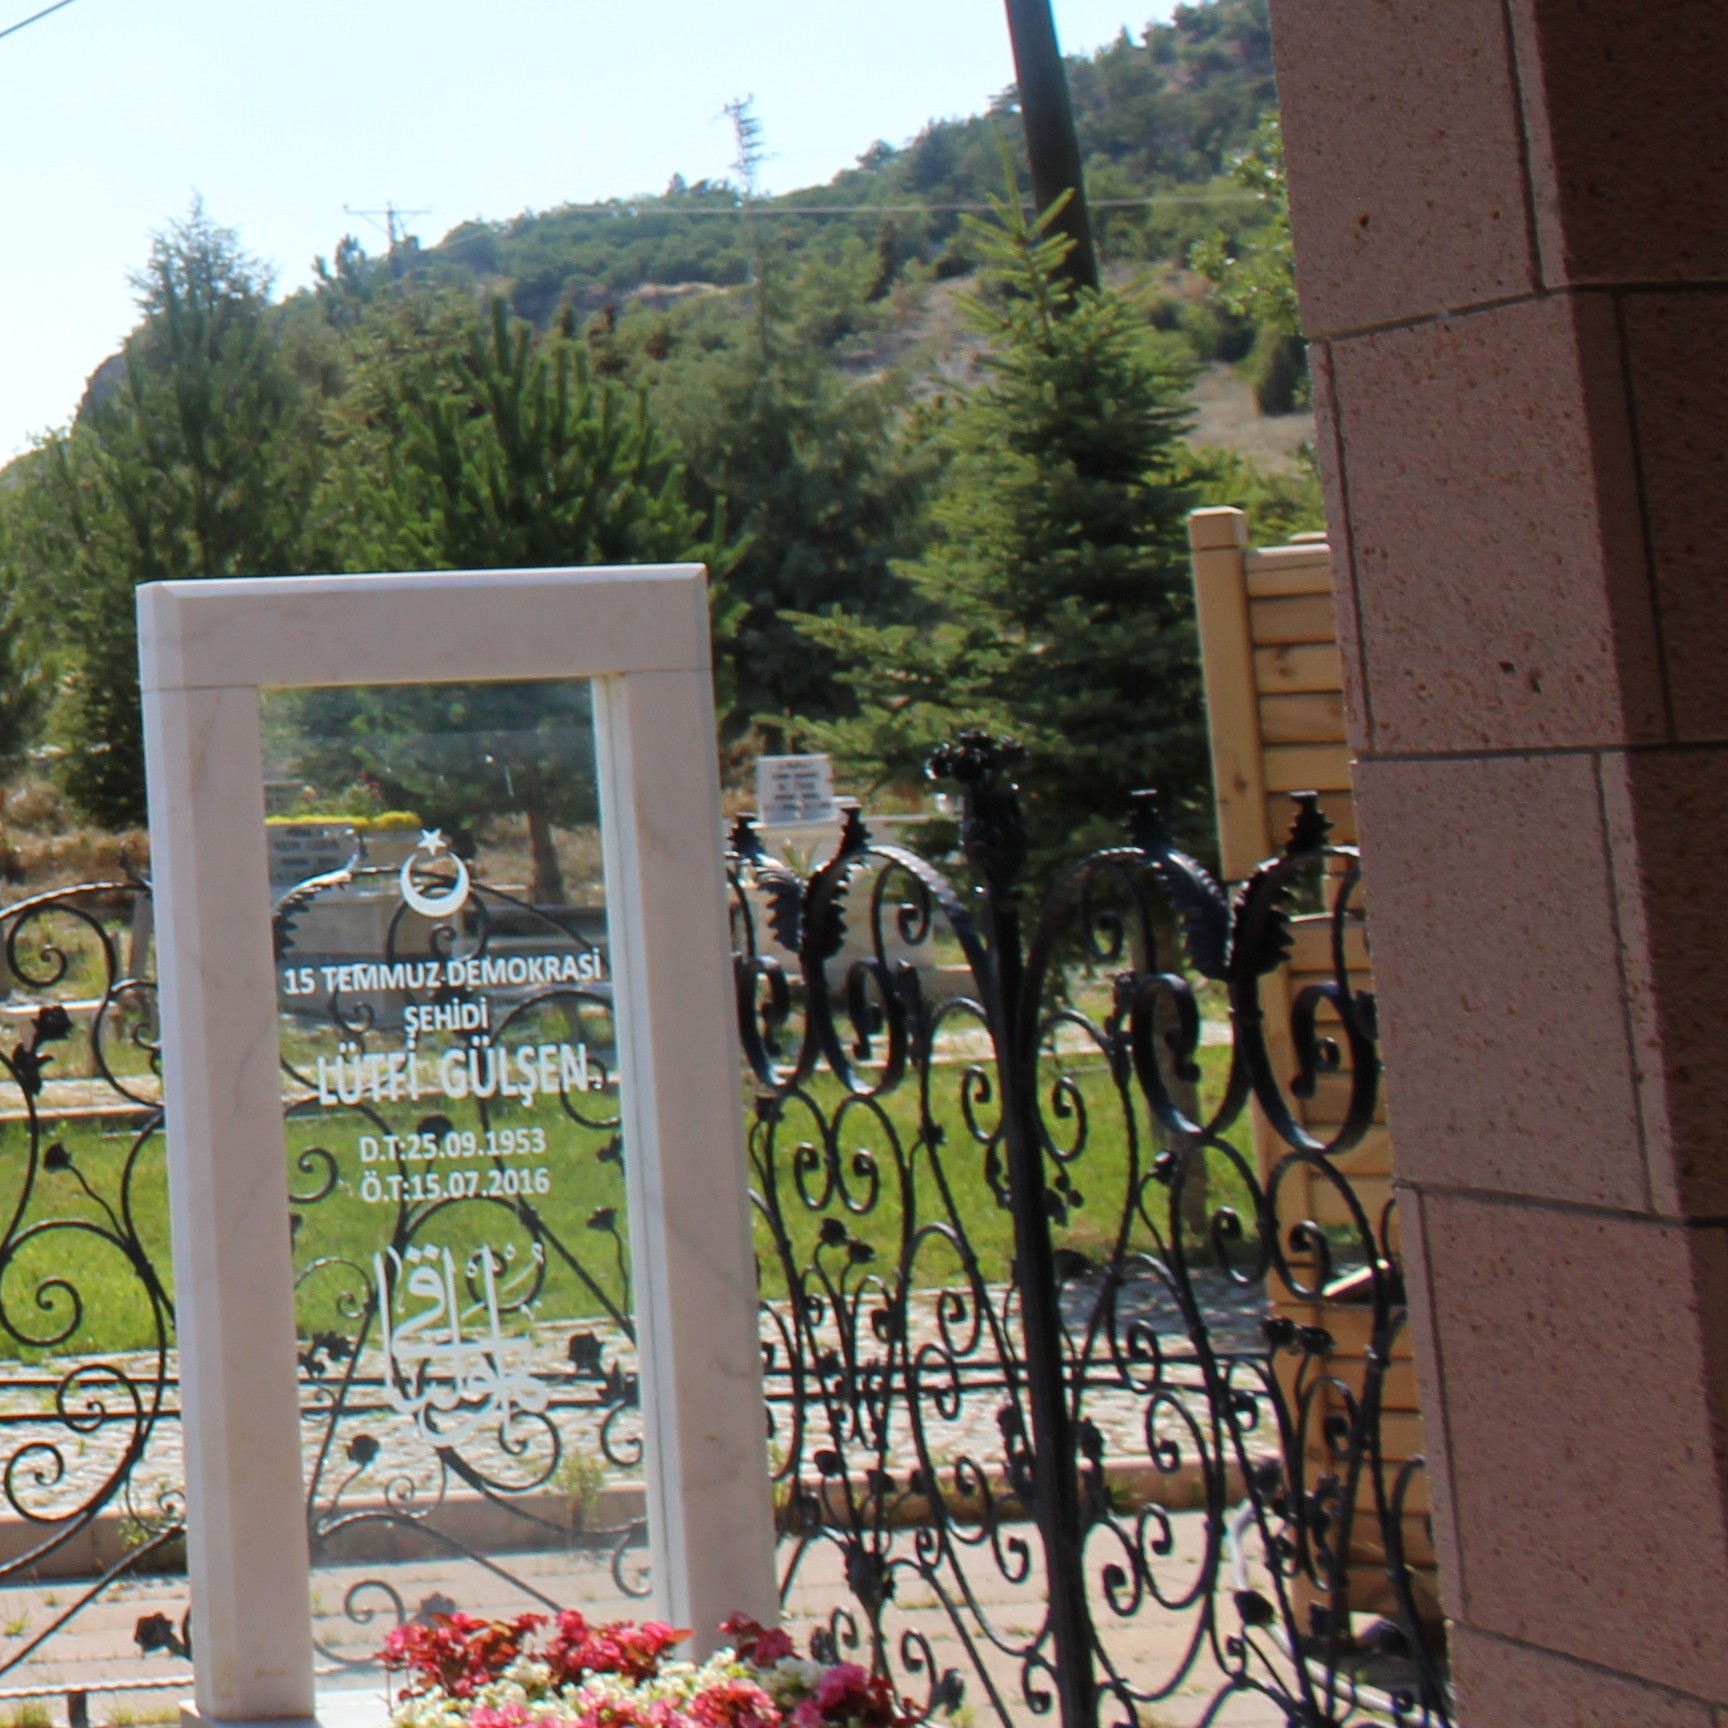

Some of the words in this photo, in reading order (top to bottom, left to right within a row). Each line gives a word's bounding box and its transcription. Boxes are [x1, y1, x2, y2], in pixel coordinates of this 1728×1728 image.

[283, 969, 316, 995] 15
[320, 961, 443, 994] TEMMUZ
[446, 947, 602, 988] DEMOKRASİ
[403, 996, 490, 1041] ŞEHİDİ
[317, 1040, 420, 1106] LÜTFİ
[439, 1035, 589, 1108] GÜLŞEN
[358, 1127, 548, 1163] D.T:25.09.1953
[360, 1167, 551, 1203] Ö.T:15.07.2016
